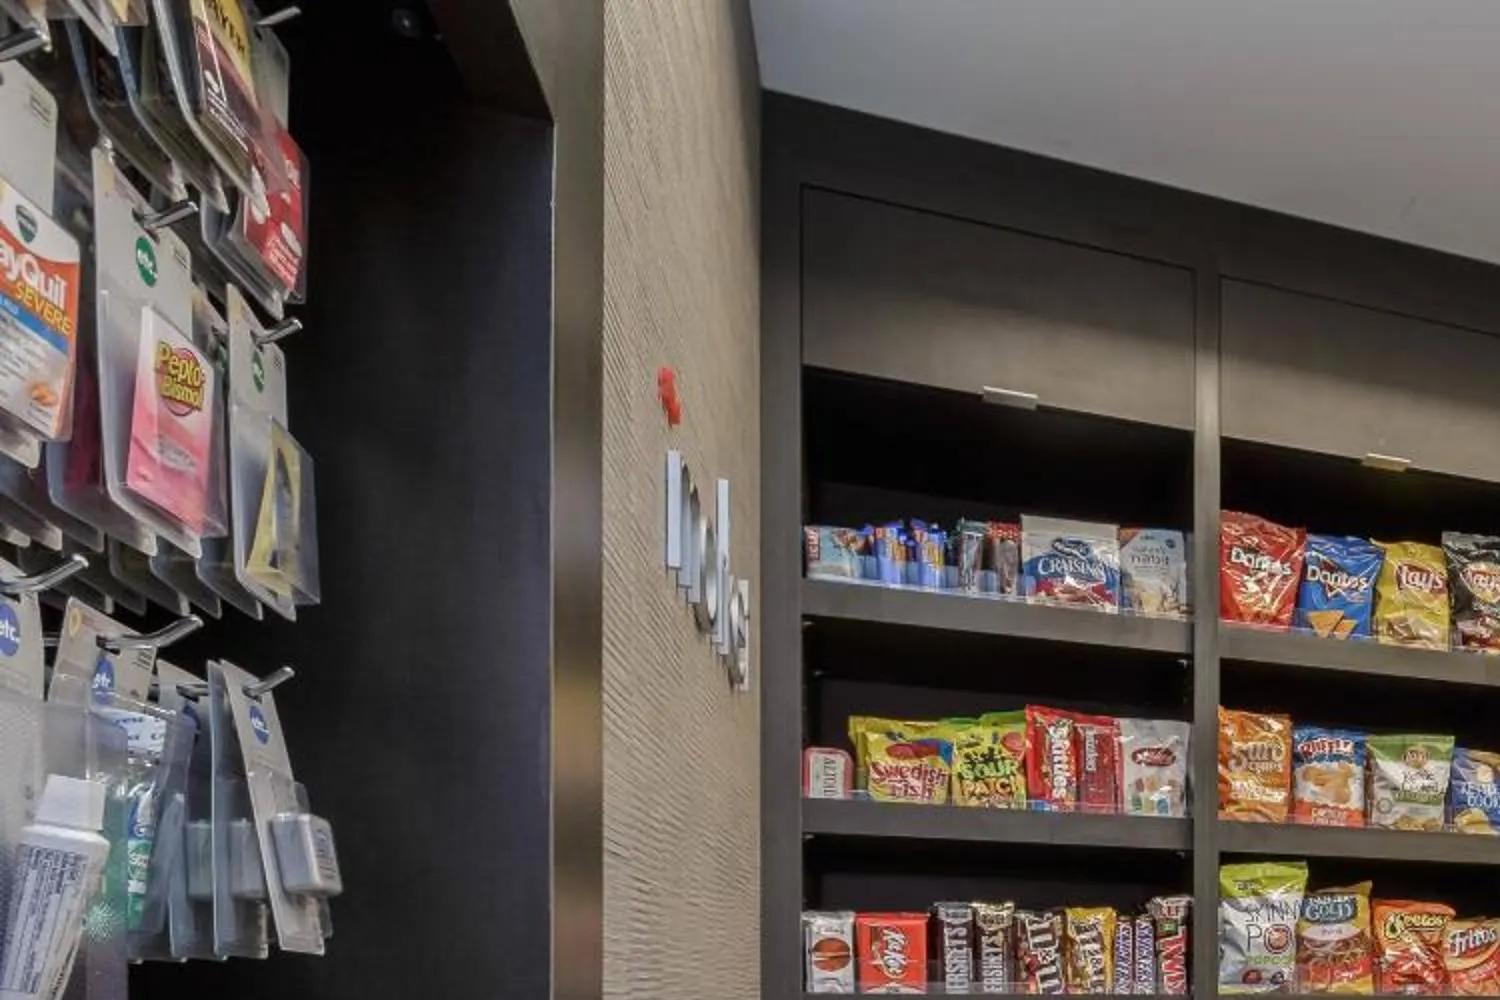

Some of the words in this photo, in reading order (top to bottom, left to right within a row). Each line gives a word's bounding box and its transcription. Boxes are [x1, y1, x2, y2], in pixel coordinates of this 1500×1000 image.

[0, 247, 67, 308] ayQuil
[15, 282, 72, 334] SEVERE
[1230, 547, 1293, 576] Doritos
[1306, 565, 1369, 592] Doritos
[871, 762, 947, 786] Swedish
[1246, 899, 1300, 922] SKINN
[1305, 903, 1354, 921] GOLD
[1449, 927, 1497, 957] Fritos
